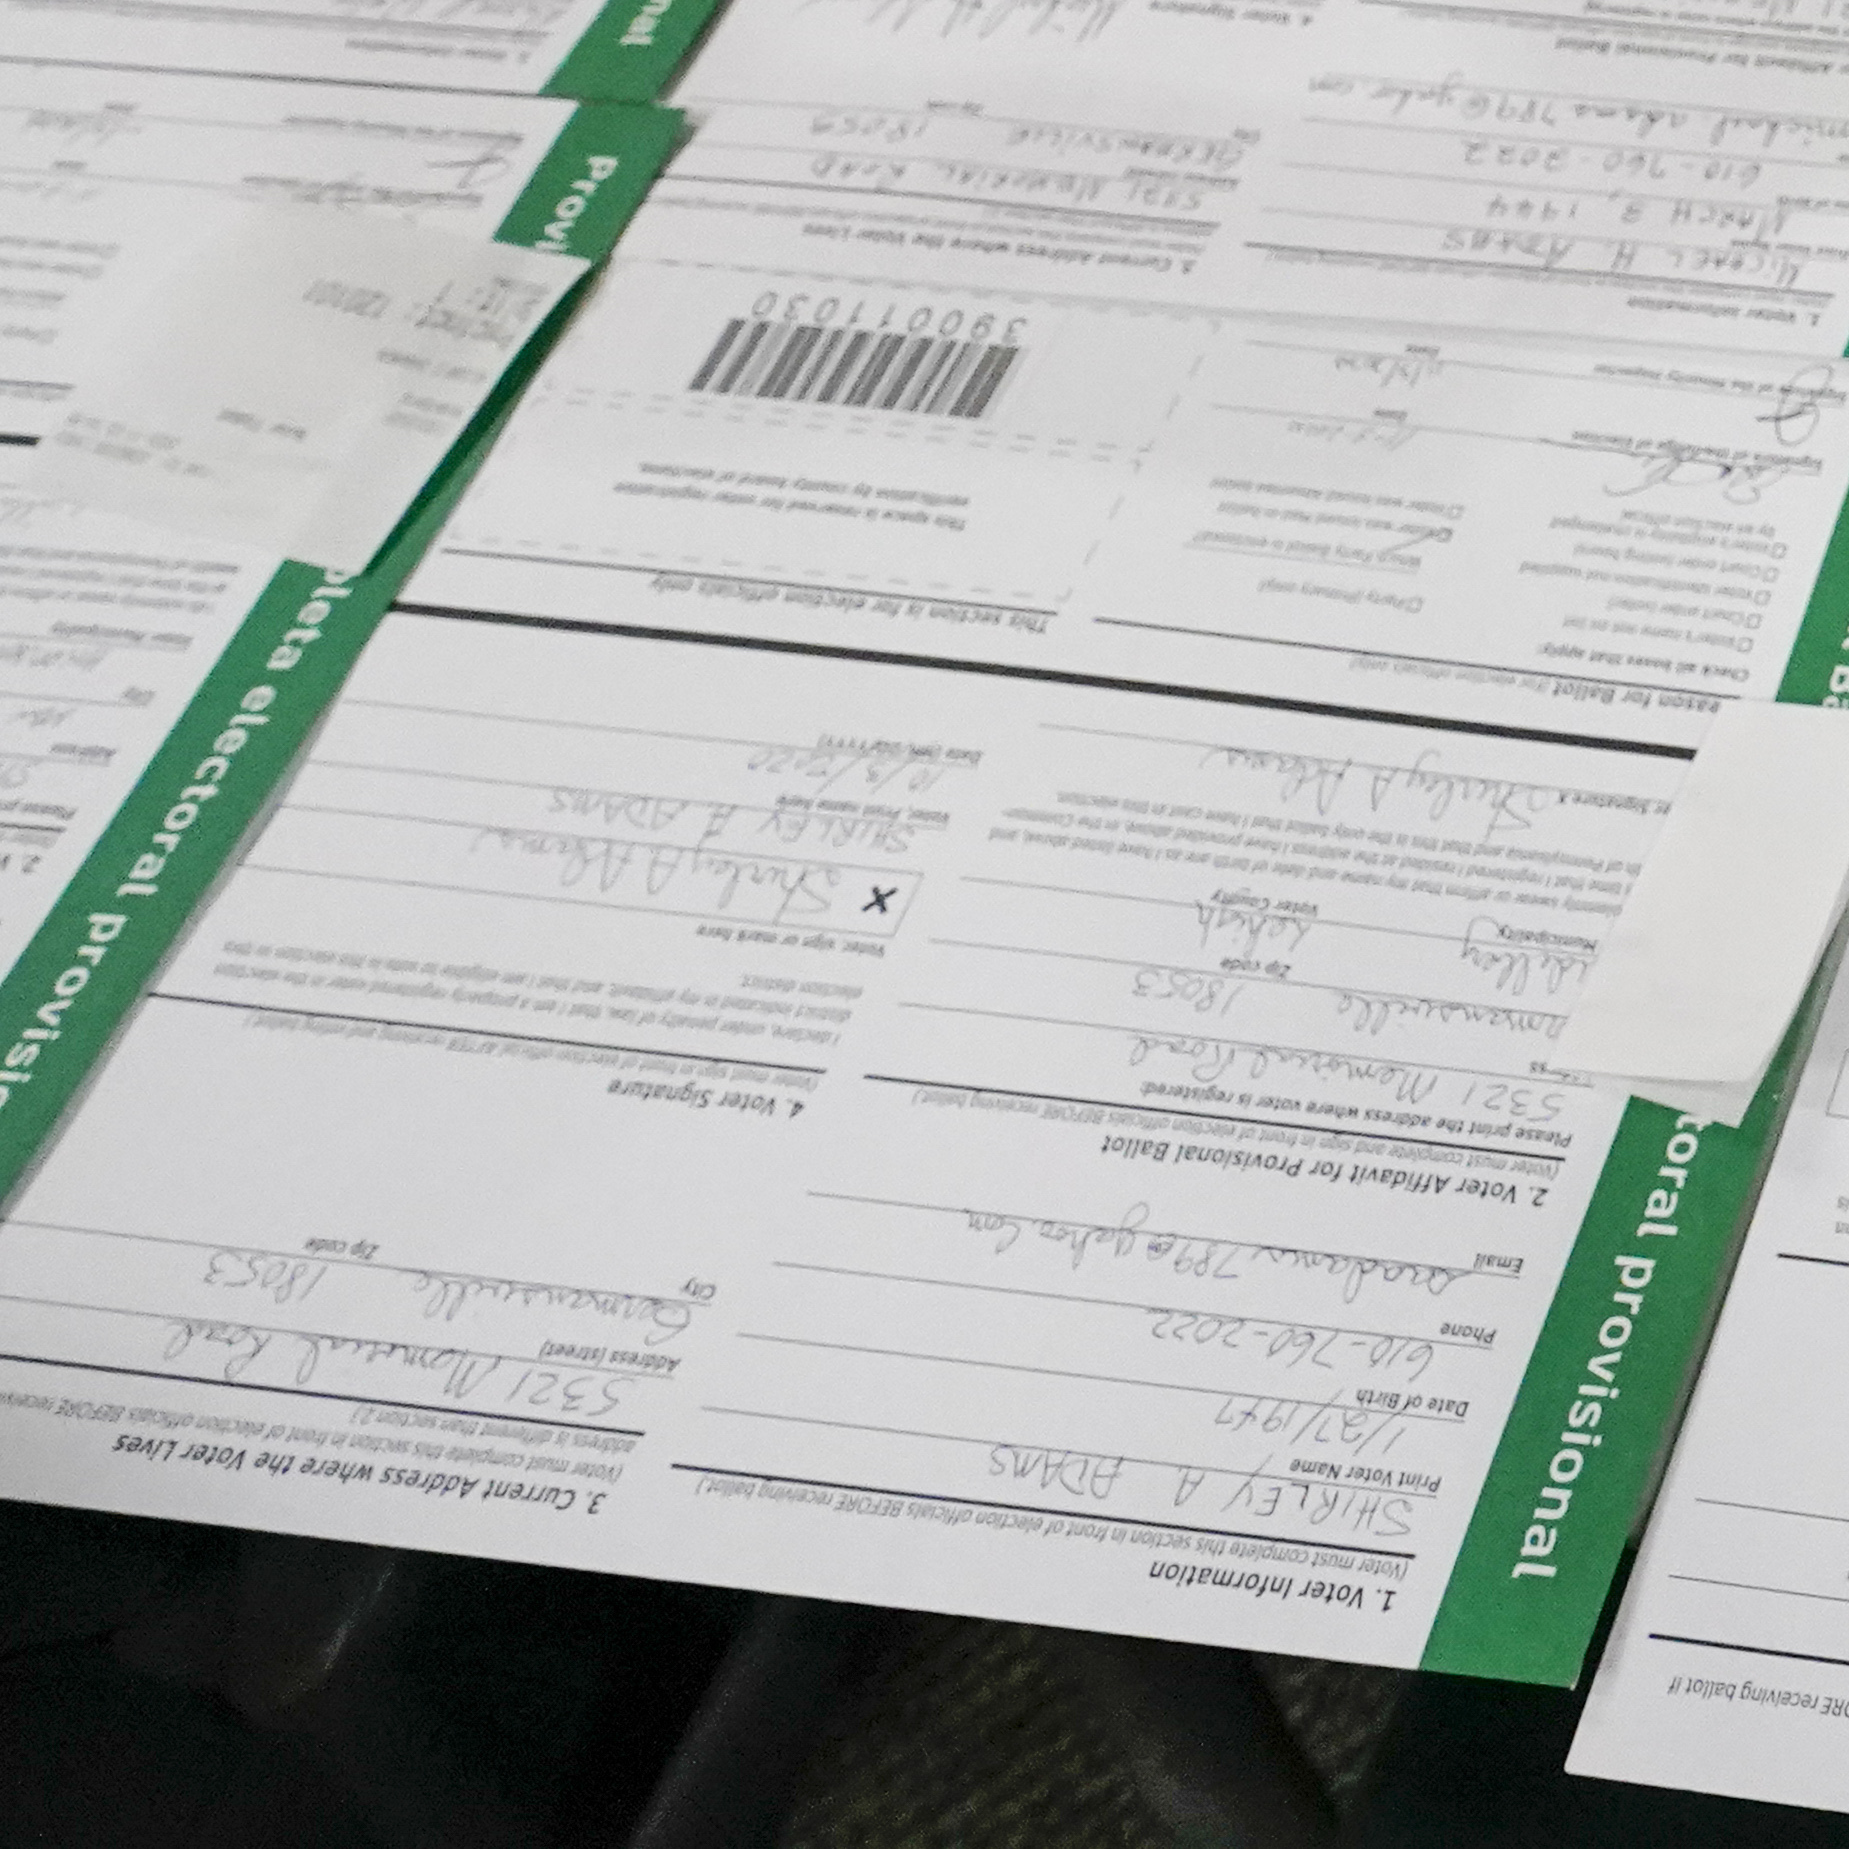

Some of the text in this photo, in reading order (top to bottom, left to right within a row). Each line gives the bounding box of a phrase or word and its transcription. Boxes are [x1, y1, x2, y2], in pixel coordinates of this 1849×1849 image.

[750, 293, 1028, 338] 390011030
[114, 683, 277, 898] electoral
[0, 911, 129, 1118] provisi
[606, 1078, 806, 1119] 4. Voter Signature
[1099, 1134, 1550, 1208] 2. Voter Affidavit for Provisional Ballot
[1509, 1254, 1657, 1579] provisional
[110, 1433, 608, 1515] 3. Current Address where the Voter Lives
[1147, 1560, 1397, 1613] 1. Voter Information
